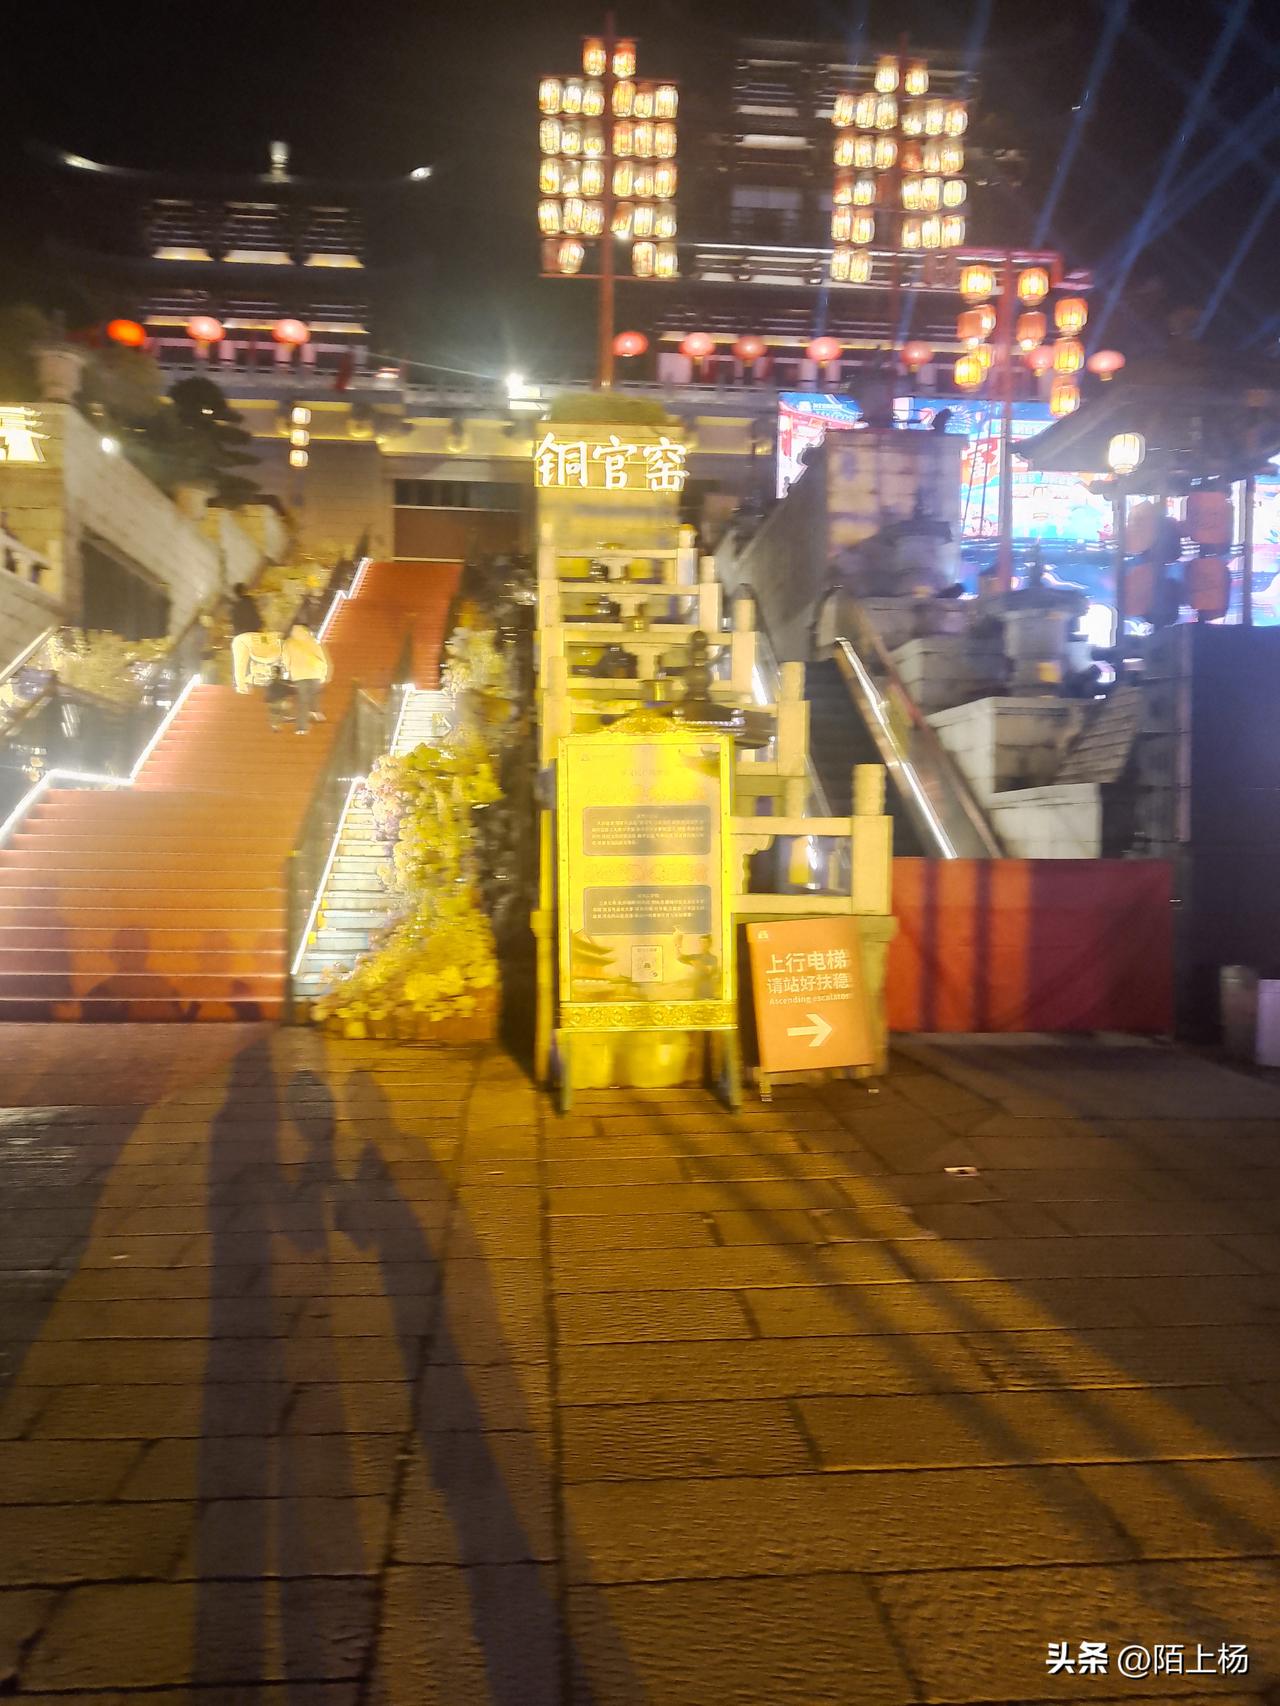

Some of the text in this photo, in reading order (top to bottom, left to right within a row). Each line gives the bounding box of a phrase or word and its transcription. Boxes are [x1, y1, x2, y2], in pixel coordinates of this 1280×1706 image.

[535, 432, 690, 491] 铜官窑
[766, 949, 849, 974] 上行电梯
[767, 973, 850, 994] 请站好扶稳
[769, 996, 812, 1005] Ascending
